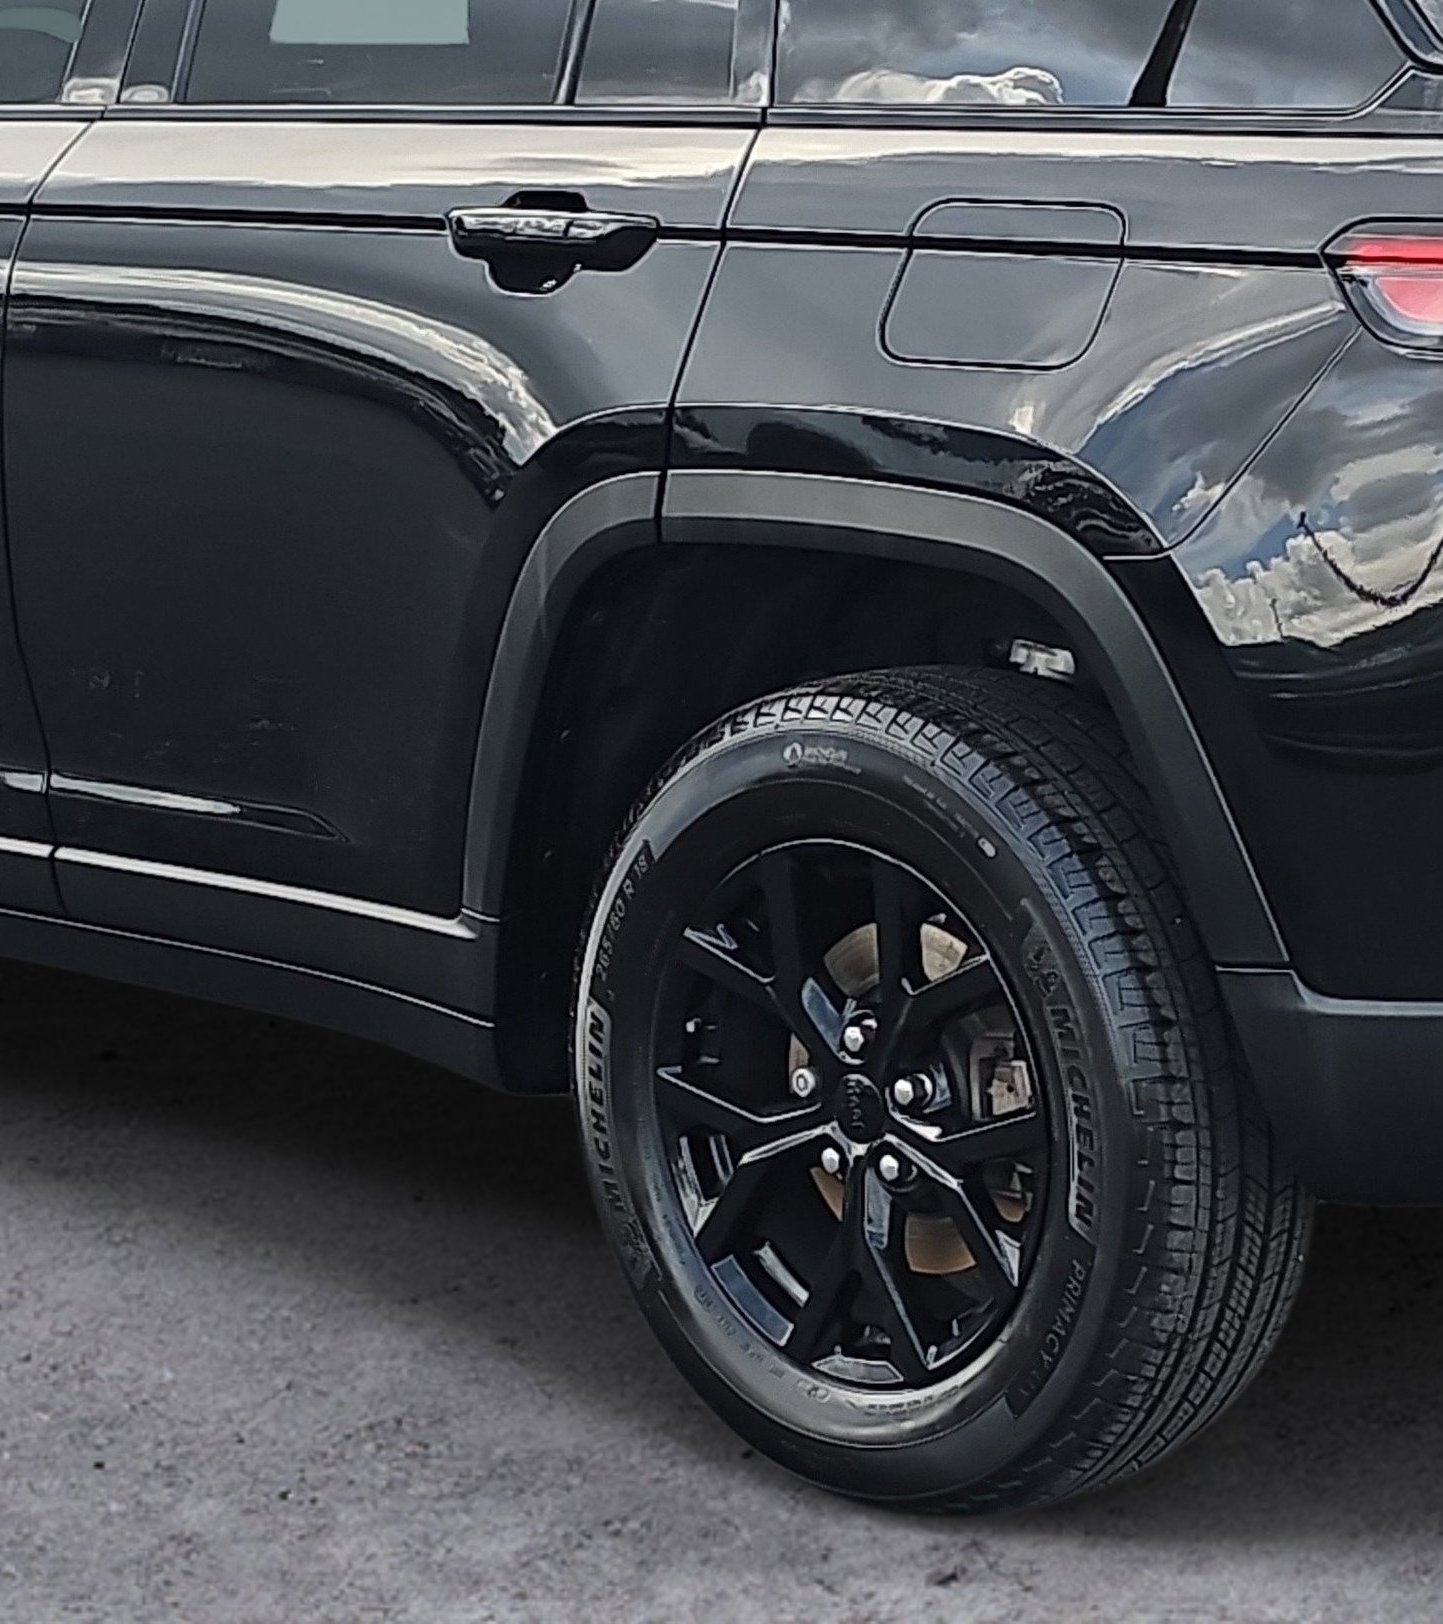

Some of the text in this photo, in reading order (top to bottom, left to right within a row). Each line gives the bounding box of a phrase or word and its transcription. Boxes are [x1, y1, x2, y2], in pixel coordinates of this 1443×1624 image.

[586, 1009, 628, 1213] MICHELIN
[1049, 1007, 1096, 1228] MICHELIN
[1040, 1258, 1087, 1369] PRIMACY
